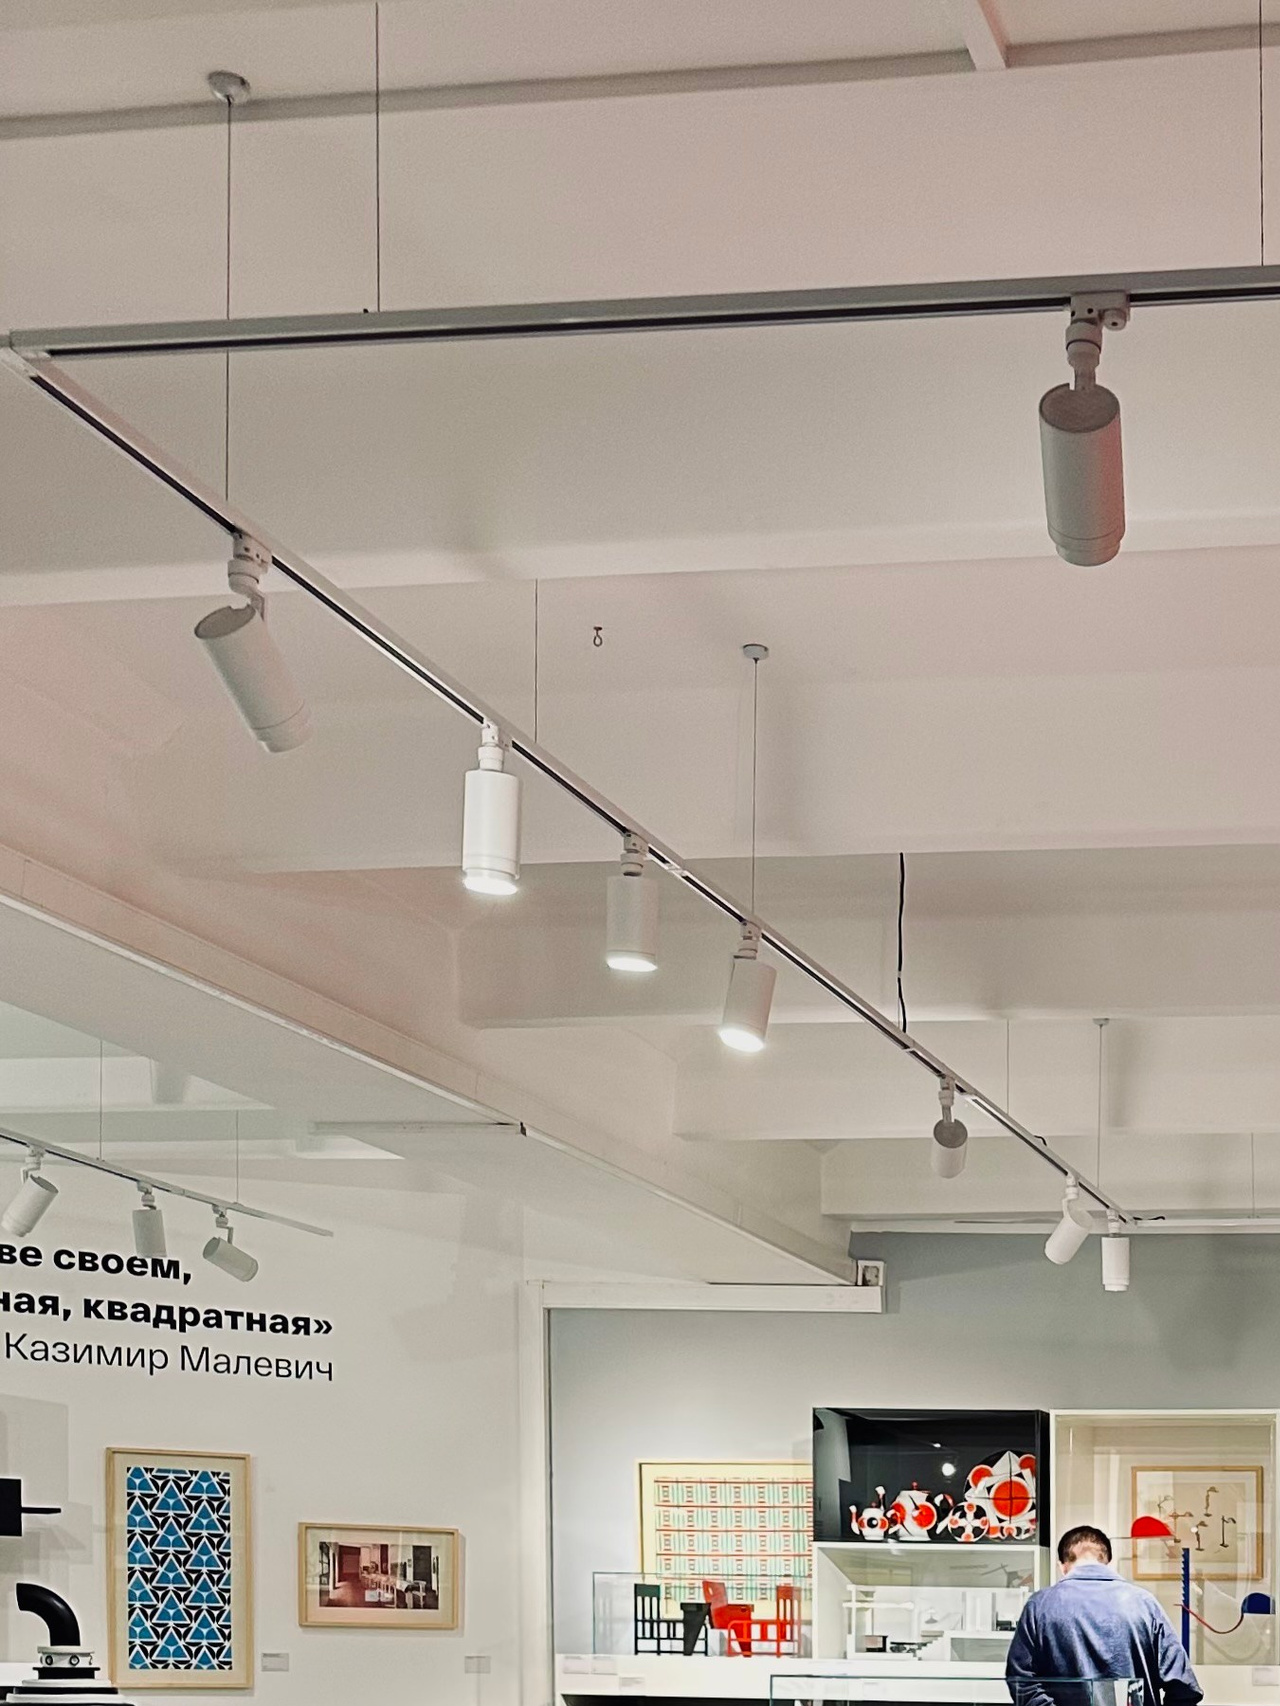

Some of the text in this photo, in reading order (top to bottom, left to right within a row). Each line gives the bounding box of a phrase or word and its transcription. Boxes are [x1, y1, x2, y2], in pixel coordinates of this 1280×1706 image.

[53, 1248, 192, 1285] своем,
[83, 1297, 333, 1336] квадратная»
[5, 1332, 334, 1381] Казимир Малевич
